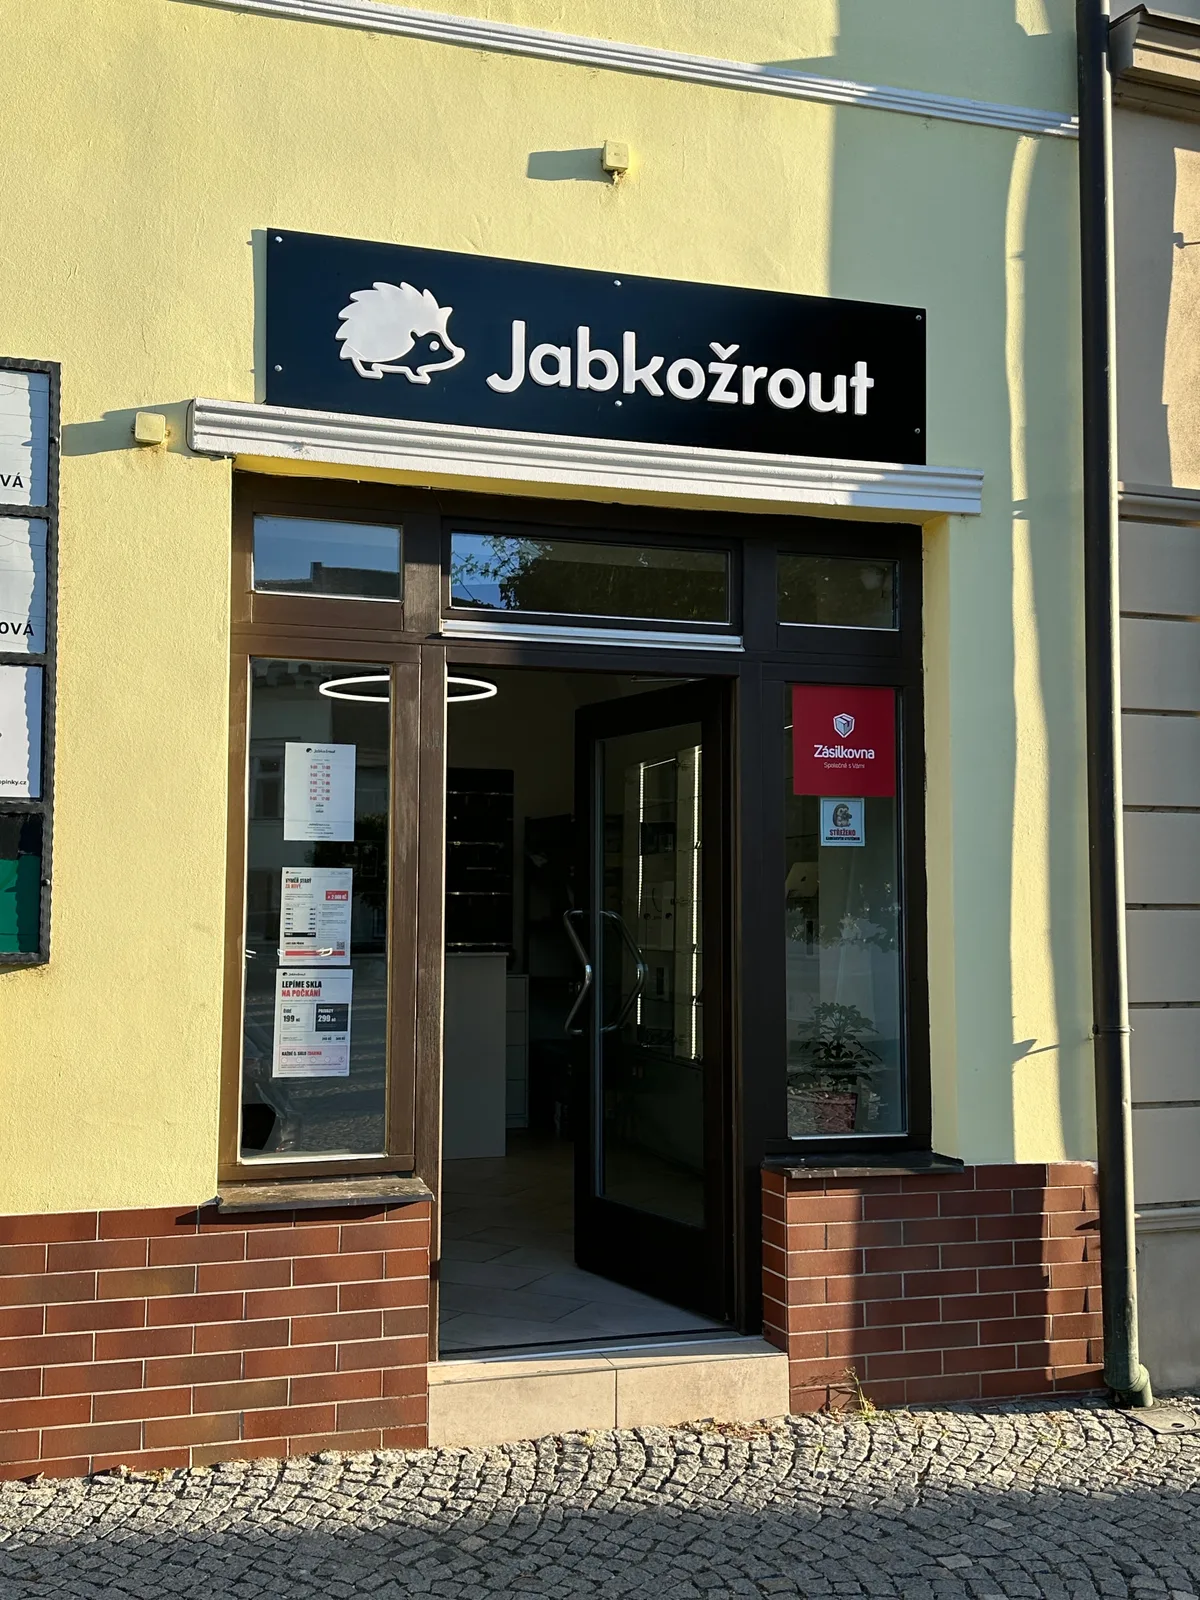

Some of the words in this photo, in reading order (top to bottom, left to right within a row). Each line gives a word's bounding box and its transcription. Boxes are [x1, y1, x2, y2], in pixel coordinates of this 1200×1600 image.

[486, 320, 874, 415] Jabkožrout
[0, 472, 24, 488] VÁ
[0, 620, 35, 636] OVÁ
[813, 745, 875, 759] Zásilkovna
[829, 828, 856, 836] STŘEŽENO
[282, 980, 305, 989] LEPÍME
[282, 989, 291, 997] NA
[292, 989, 321, 997] POČKÁNÍ
[283, 1014, 295, 1022] 199
[318, 1014, 331, 1022] 299
